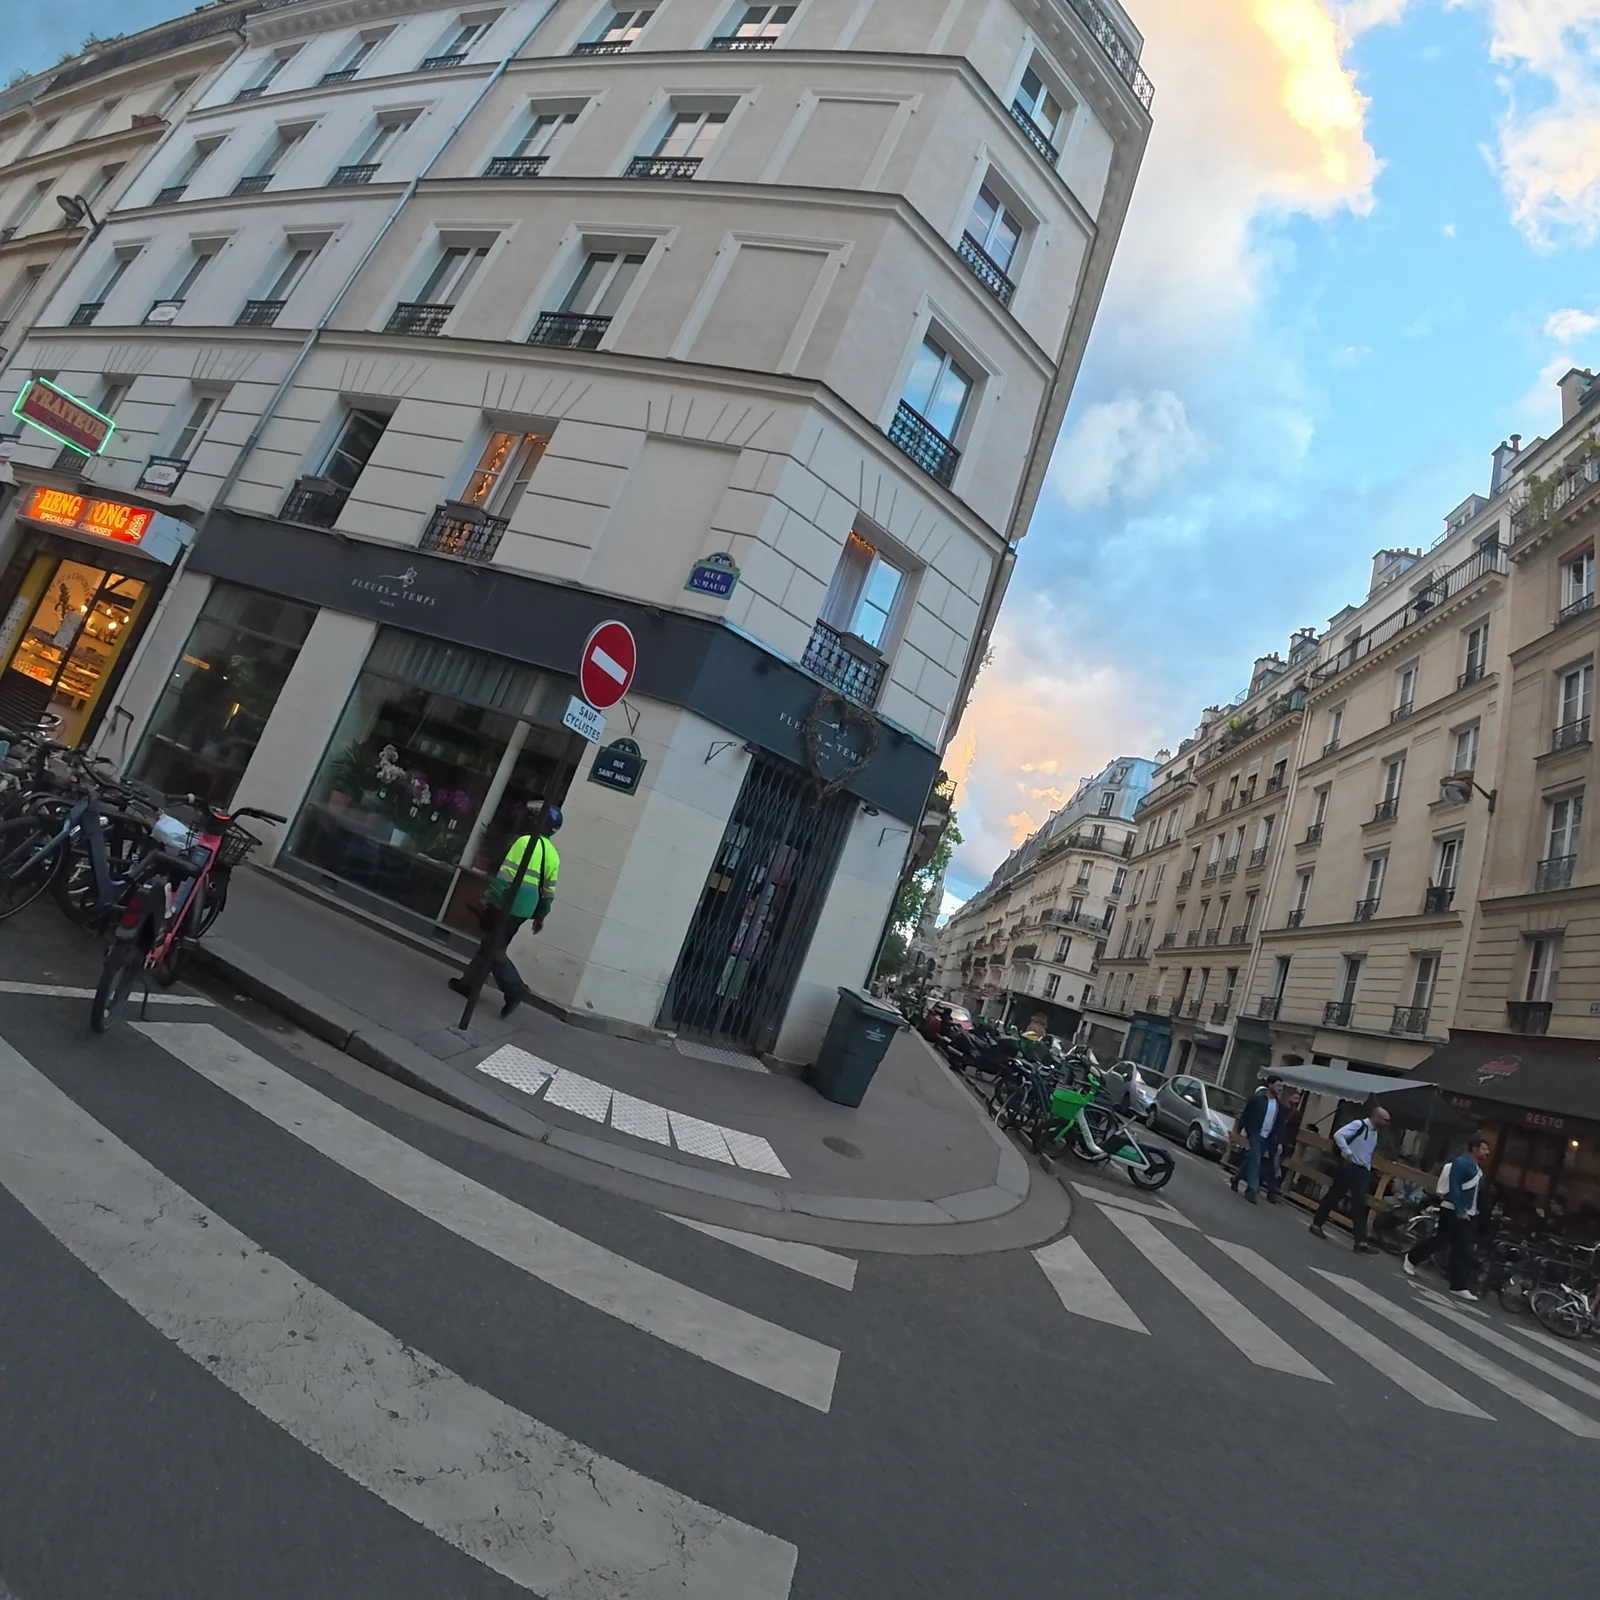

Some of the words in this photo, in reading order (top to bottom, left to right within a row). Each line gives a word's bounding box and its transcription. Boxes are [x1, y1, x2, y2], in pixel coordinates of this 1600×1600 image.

[30, 383, 107, 441] TRAITEUR
[38, 489, 83, 518] HENG
[85, 499, 131, 529] TONG
[39, 511, 77, 528] SPECIALITES
[78, 521, 113, 537] CHINOISES
[701, 580, 727, 593] MAUR
[703, 570, 723, 581] RUE
[351, 578, 390, 595] FLEURS
[402, 590, 437, 607] TEMPS
[565, 712, 601, 741] CYCLISTES
[578, 705, 598, 724] SAUF
[597, 767, 615, 779] SAINT
[613, 772, 632, 785] MAUR
[612, 759, 626, 770] RUE
[1451, 1096, 1472, 1110] BAR
[1525, 1111, 1564, 1129] RESTO
